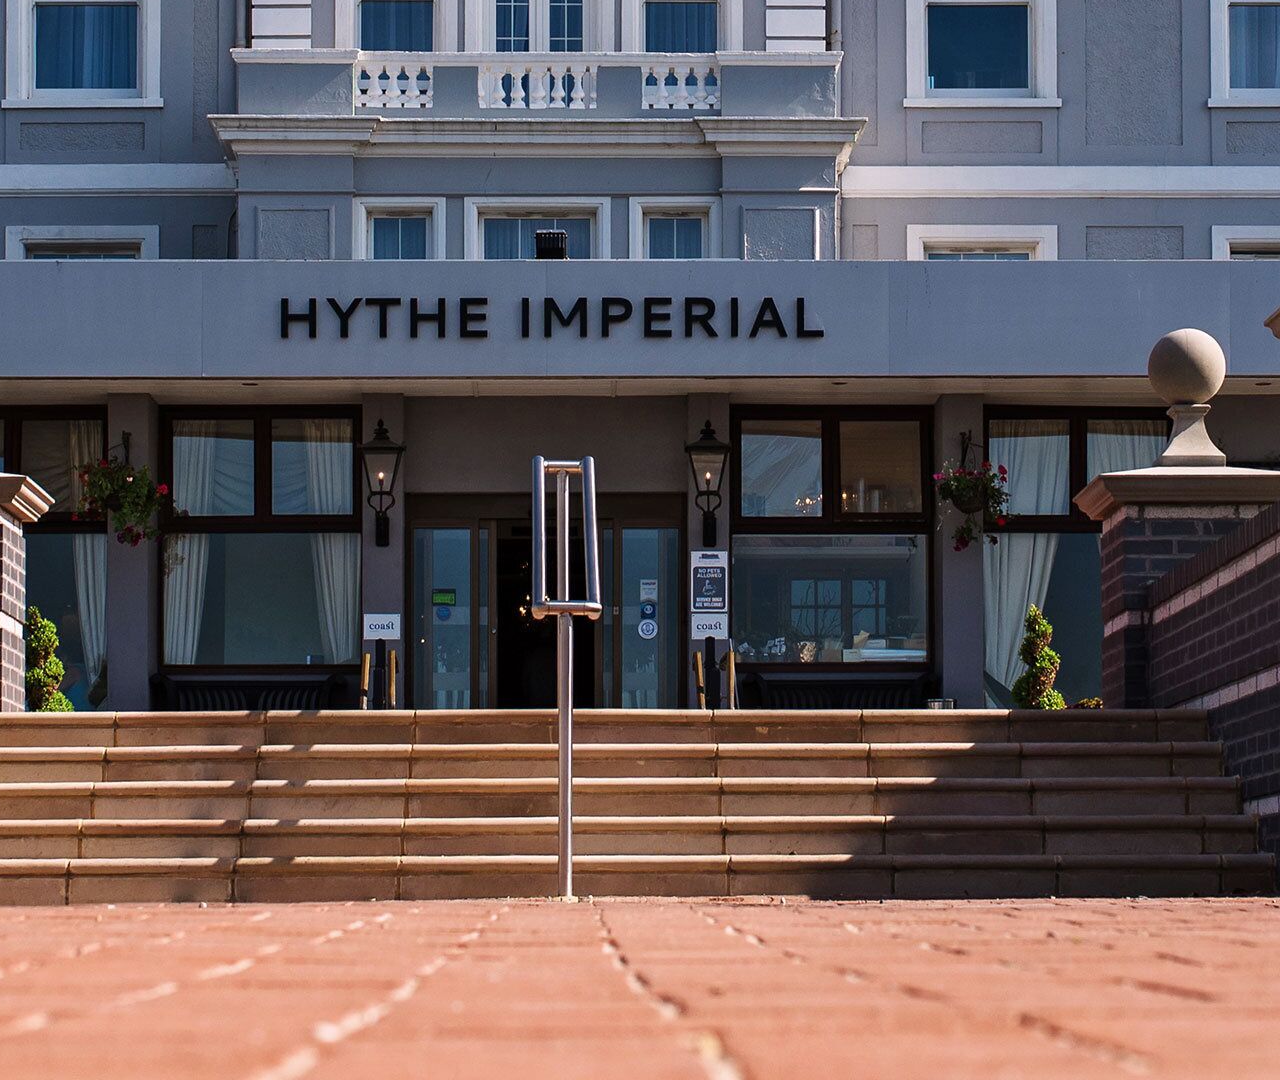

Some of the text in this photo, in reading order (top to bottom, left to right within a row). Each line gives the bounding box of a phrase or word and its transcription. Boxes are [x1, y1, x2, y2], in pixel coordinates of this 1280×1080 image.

[280, 297, 825, 339] HYTHE IMPERIAL
[368, 621, 394, 630] coast
[696, 621, 723, 631] coast
